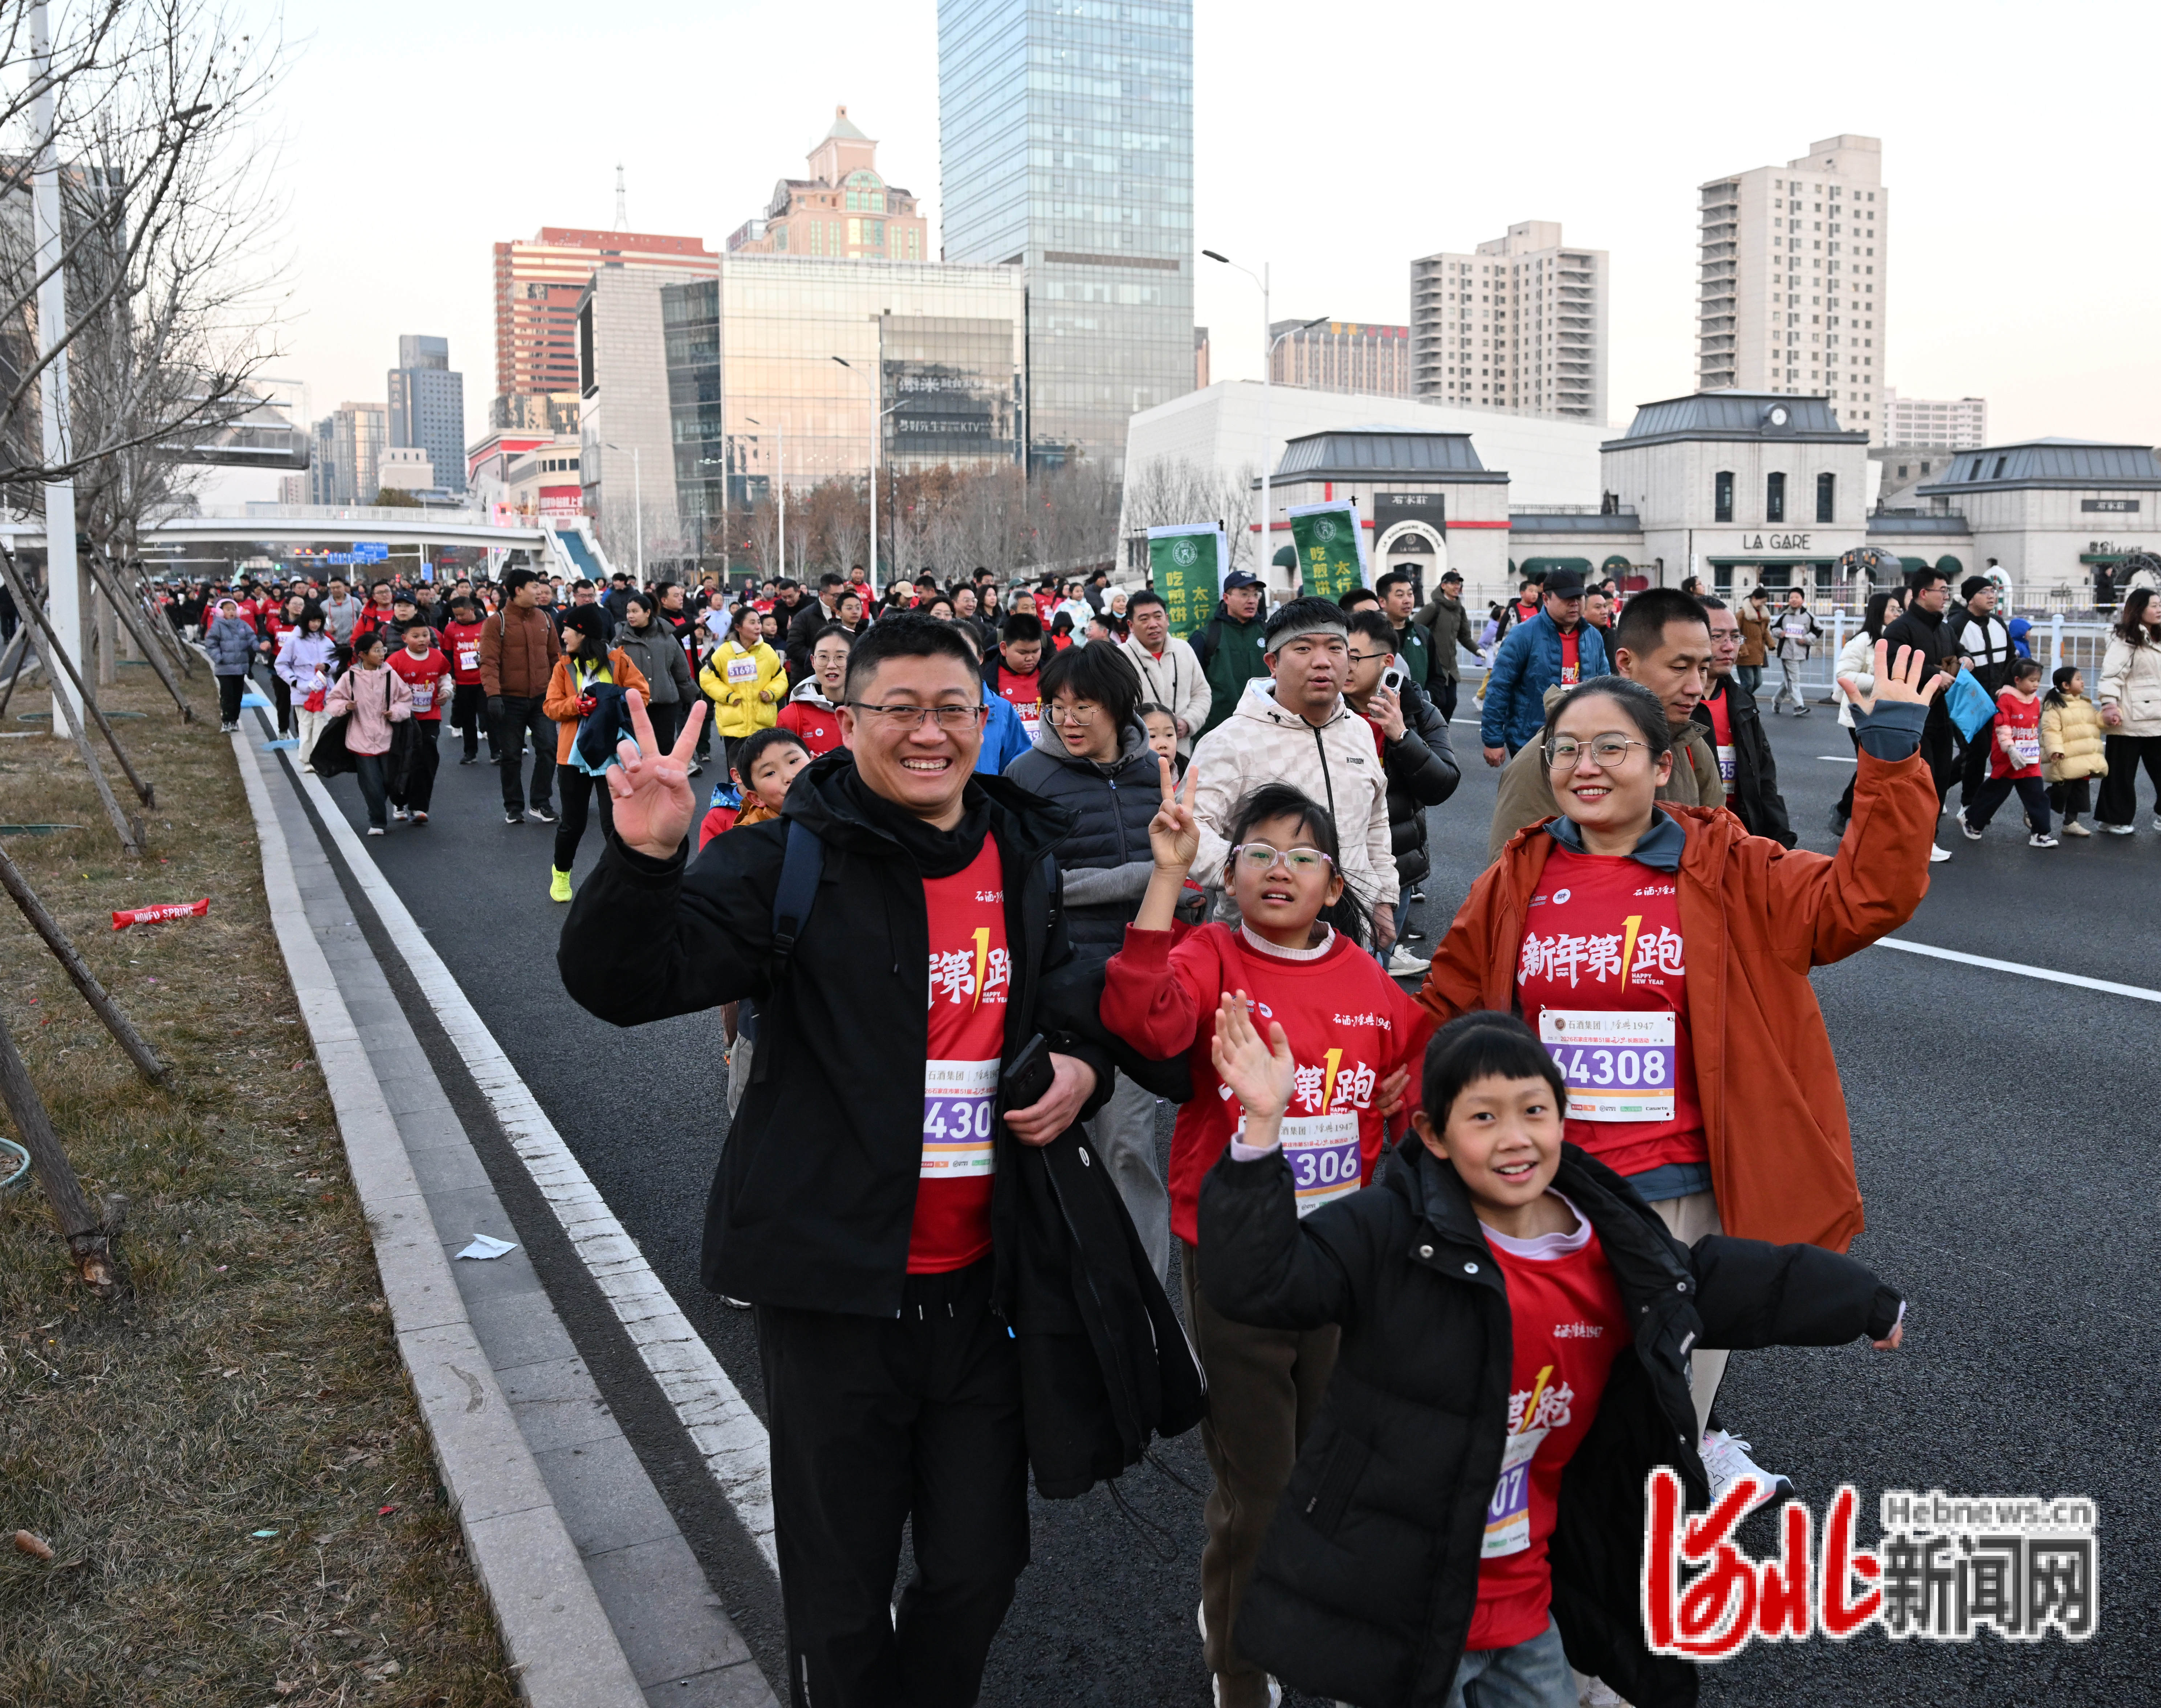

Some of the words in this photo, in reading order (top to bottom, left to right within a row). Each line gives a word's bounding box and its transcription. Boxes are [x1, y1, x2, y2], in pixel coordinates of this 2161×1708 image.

[1743, 534, 1763, 549] LA
[1770, 534, 1811, 549] GARE
[1310, 546, 1330, 595] 吃煎饼
[1334, 561, 1353, 593] 太行
[729, 665, 754, 676] 51699
[162, 906, 194, 918] SPRING
[1517, 915, 1685, 994] 新年第1跑
[1568, 1021, 1601, 1030] 石酒集团
[928, 1071, 964, 1080] 石酒集团
[923, 1101, 997, 1139] 430
[1283, 1147, 1357, 1186] 306
